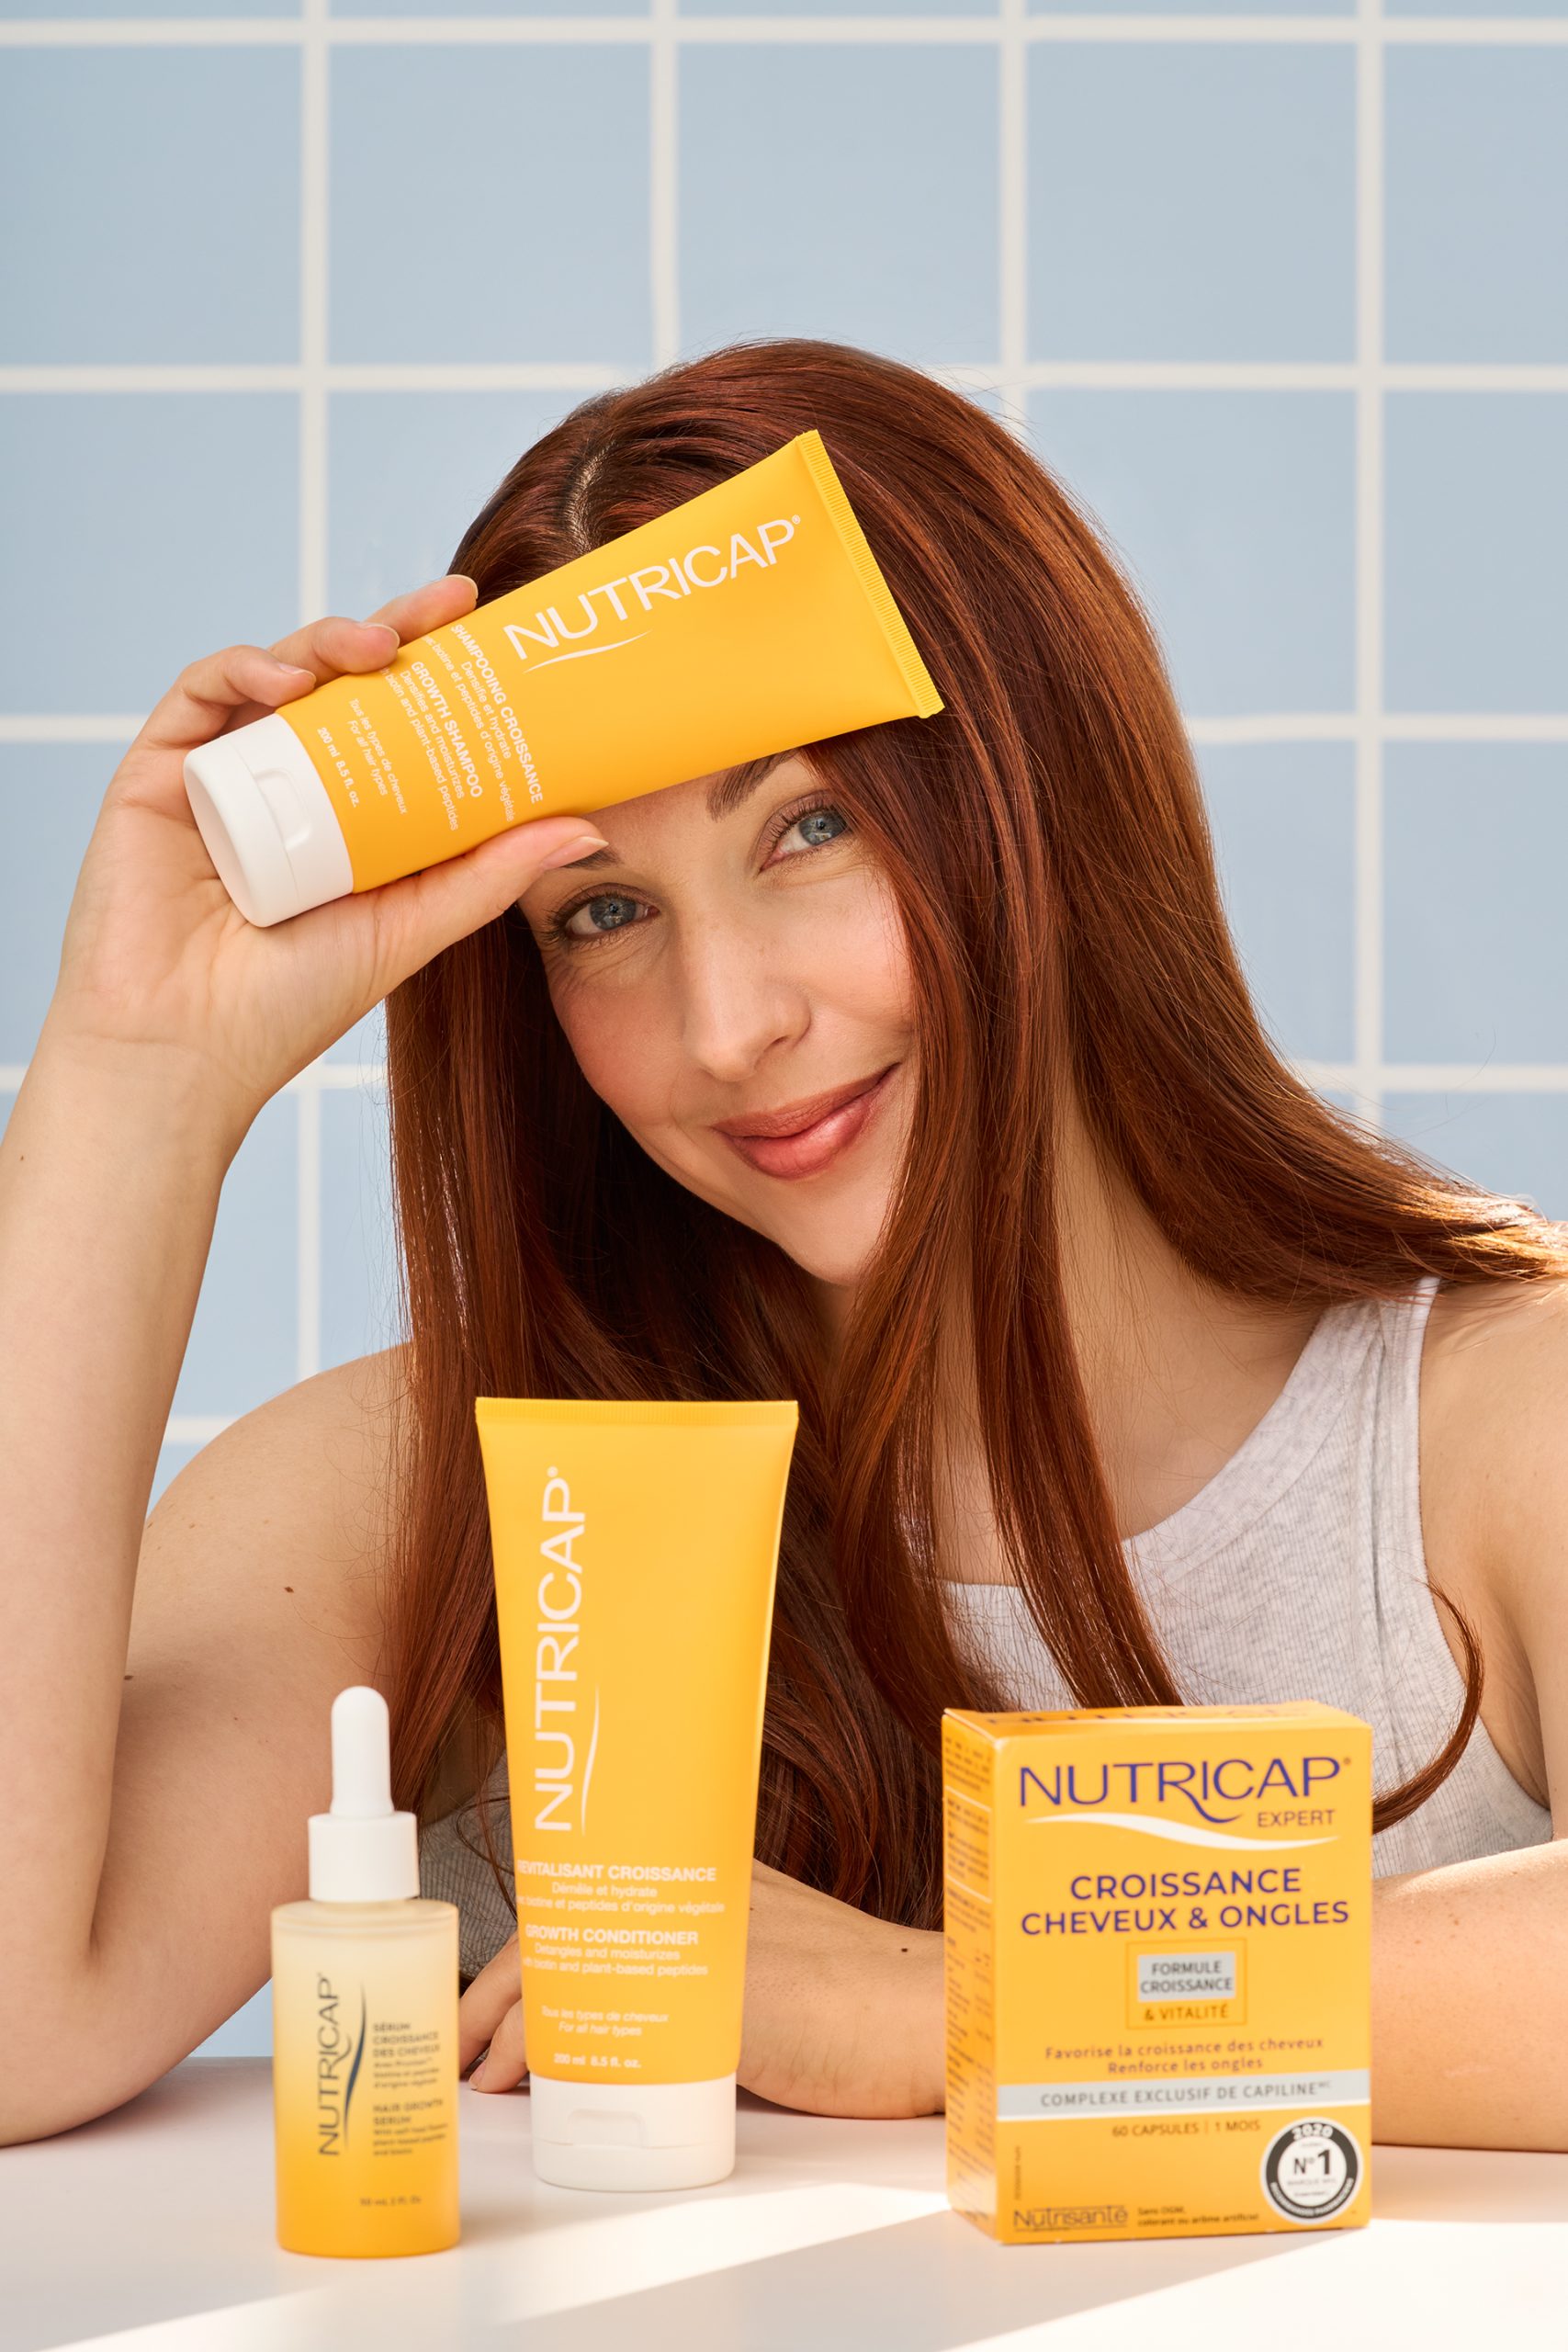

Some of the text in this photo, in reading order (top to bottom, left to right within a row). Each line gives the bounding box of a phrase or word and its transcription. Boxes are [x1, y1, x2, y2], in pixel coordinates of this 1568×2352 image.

[432, 643, 454, 671] biotine
[451, 672, 462, 682] et
[451, 625, 542, 803] SHAMPOOING CROISSANCE
[456, 684, 484, 729] peptides
[461, 662, 511, 758] Densifie et hydrate
[400, 671, 464, 798] Densifies and moisturizes
[412, 662, 482, 797] GROWTH SHAMPOO
[348, 720, 388, 795] For all hair types
[360, 718, 371, 729] les
[367, 731, 385, 756] types
[381, 759, 391, 771] de
[388, 774, 406, 813] cheveux
[401, 698, 418, 717] and
[411, 718, 447, 784] plant-based
[438, 786, 457, 830] peptides
[480, 731, 503, 779] d'origine
[318, 728, 333, 743] 200
[336, 761, 349, 777] 8.5
[344, 778, 354, 788] fl.
[349, 791, 359, 807] oz.
[500, 781, 514, 820] végétale
[1258, 1809, 1335, 1827] EXPERT
[608, 1865, 716, 1882] CROISSANCE
[1071, 1869, 1301, 1900] CROISSANCE
[596, 1885, 608, 1895] et
[611, 1885, 658, 1898] hydrate
[568, 1900, 618, 1911] peptides
[621, 1901, 675, 1916] d'origine
[1021, 1908, 1176, 1935] CHEVEUX
[1189, 1907, 1207, 1929] &
[1220, 1902, 1348, 1928] ONGLES
[526, 1924, 698, 1945] GROWTH CONDITIONER
[585, 1948, 608, 1959] and
[610, 1949, 680, 1961] moisturizes
[558, 1962, 580, 1973] and
[581, 1962, 654, 1975] plant-based
[657, 1965, 708, 1977] peptides
[1152, 1961, 1220, 1975] FORMULE
[1140, 1977, 1231, 1994] CROISSANCE
[606, 2012, 621, 2021] de
[1145, 2003, 1227, 2021] & VITALITÉ
[1045, 2038, 1322, 2064] Favorise la croissance des cheveux
[1108, 2056, 1262, 2074] Renforce les ongles
[1041, 2091, 1126, 2107] COMPLEXE
[1134, 2087, 1210, 2103] EXCLUSIF
[1217, 2086, 1235, 2099] DE
[1112, 2120, 1260, 2137] 60 CAPSULES 1 MOIS
[1292, 2123, 1334, 2141] 2020
[1013, 2204, 1129, 2230] Nutrisanté
